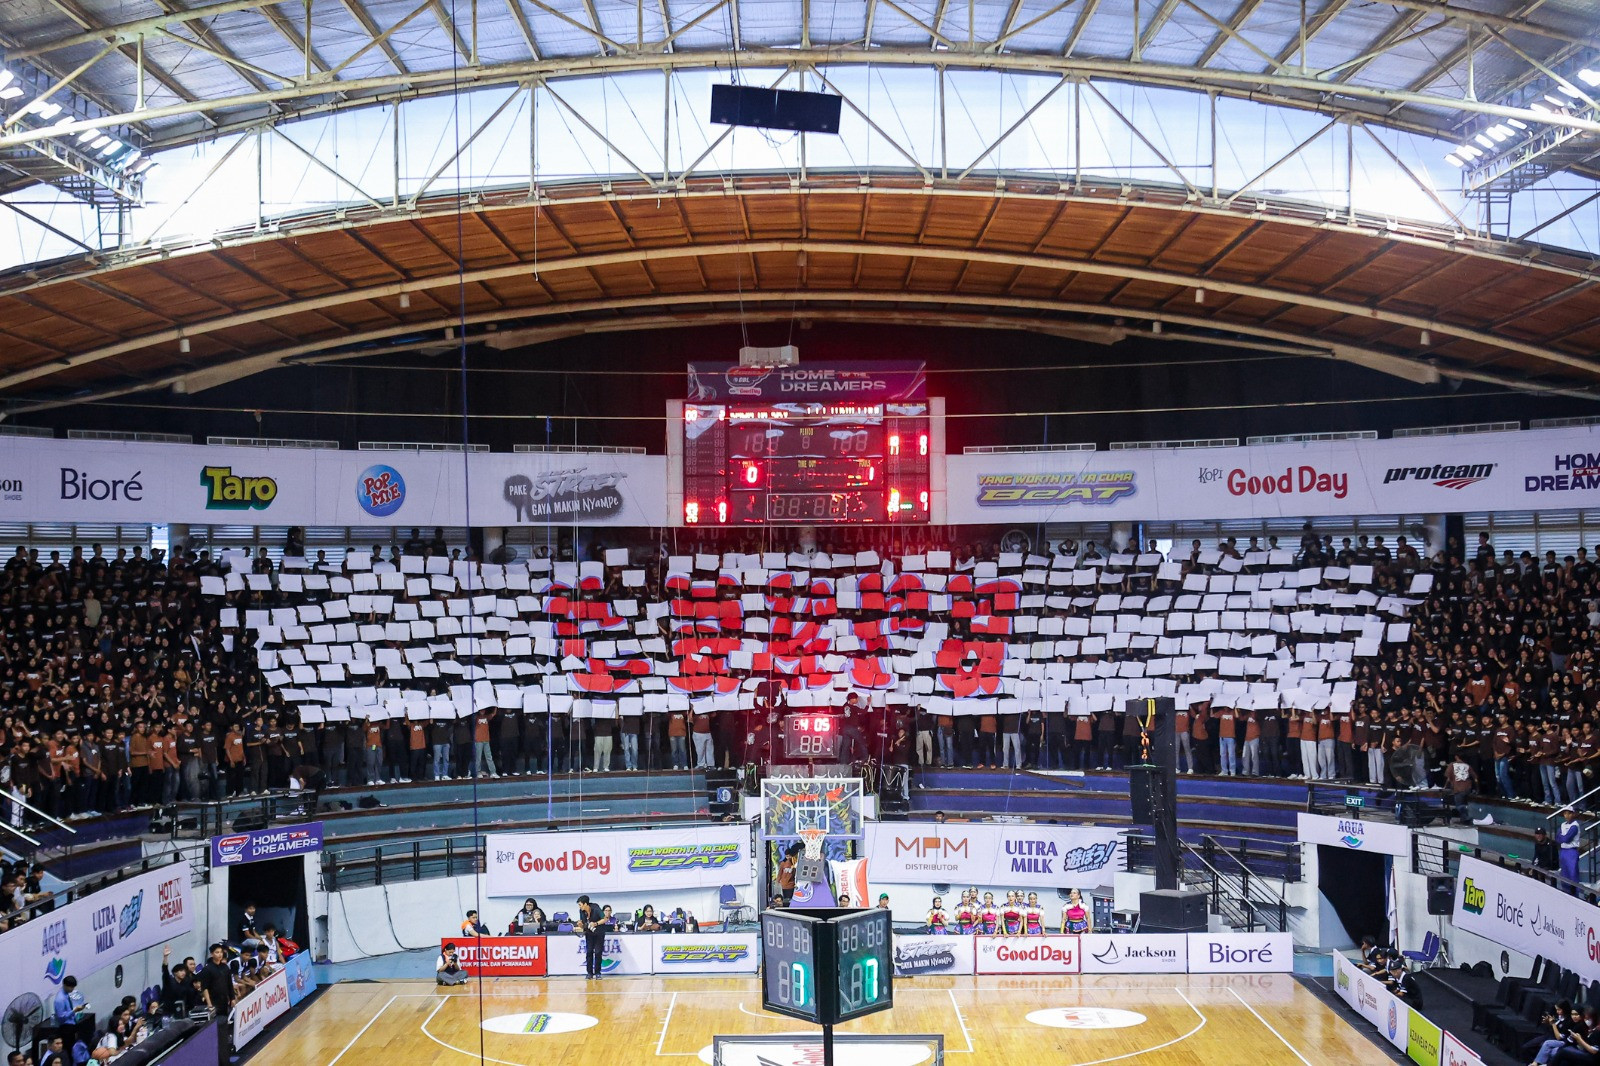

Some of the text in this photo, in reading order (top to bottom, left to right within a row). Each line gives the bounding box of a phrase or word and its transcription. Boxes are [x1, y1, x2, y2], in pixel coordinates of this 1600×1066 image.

[781, 370, 835, 380] HOME
[781, 381, 887, 392] DREAMERS
[363, 472, 391, 496] POP
[979, 475, 1013, 485] YANG
[1015, 474, 1060, 484] WORTH
[1081, 473, 1097, 483] YA
[1098, 473, 1134, 483] CUMA
[1227, 468, 1292, 496] Good
[1298, 466, 1348, 499] Day
[1383, 463, 1494, 484] proteam
[60, 468, 143, 501] Bioré
[203, 466, 278, 505] Taro
[509, 484, 527, 496] PAKE
[530, 473, 628, 500] STREET
[532, 502, 552, 516] GAYA
[554, 500, 580, 513] MAKIN
[1346, 797, 1362, 805] EXIT
[252, 832, 288, 845] HOME
[1338, 820, 1364, 836] AQUA
[252, 838, 318, 856] DREAMERS
[655, 846, 685, 854] WORTH
[895, 837, 968, 859] MPM
[1005, 840, 1058, 857] ULTRA
[518, 851, 568, 873] Good
[572, 850, 611, 875] Day
[905, 863, 958, 871] DISTRIBUTOR
[1011, 858, 1053, 874] MILK
[158, 882, 172, 903] HOT
[1463, 877, 1485, 912] Taro
[92, 905, 116, 931] ULTRA
[160, 898, 183, 921] CREAM
[1497, 893, 1523, 927] Bioré
[1543, 916, 1564, 939] Jackson
[96, 928, 115, 954] MILK
[492, 946, 539, 960] CREAM
[996, 946, 1038, 961] Good
[1041, 946, 1072, 965] Day
[1125, 946, 1176, 958] Jackson
[1208, 942, 1272, 963] Bioré
[240, 997, 262, 1028] AHM
